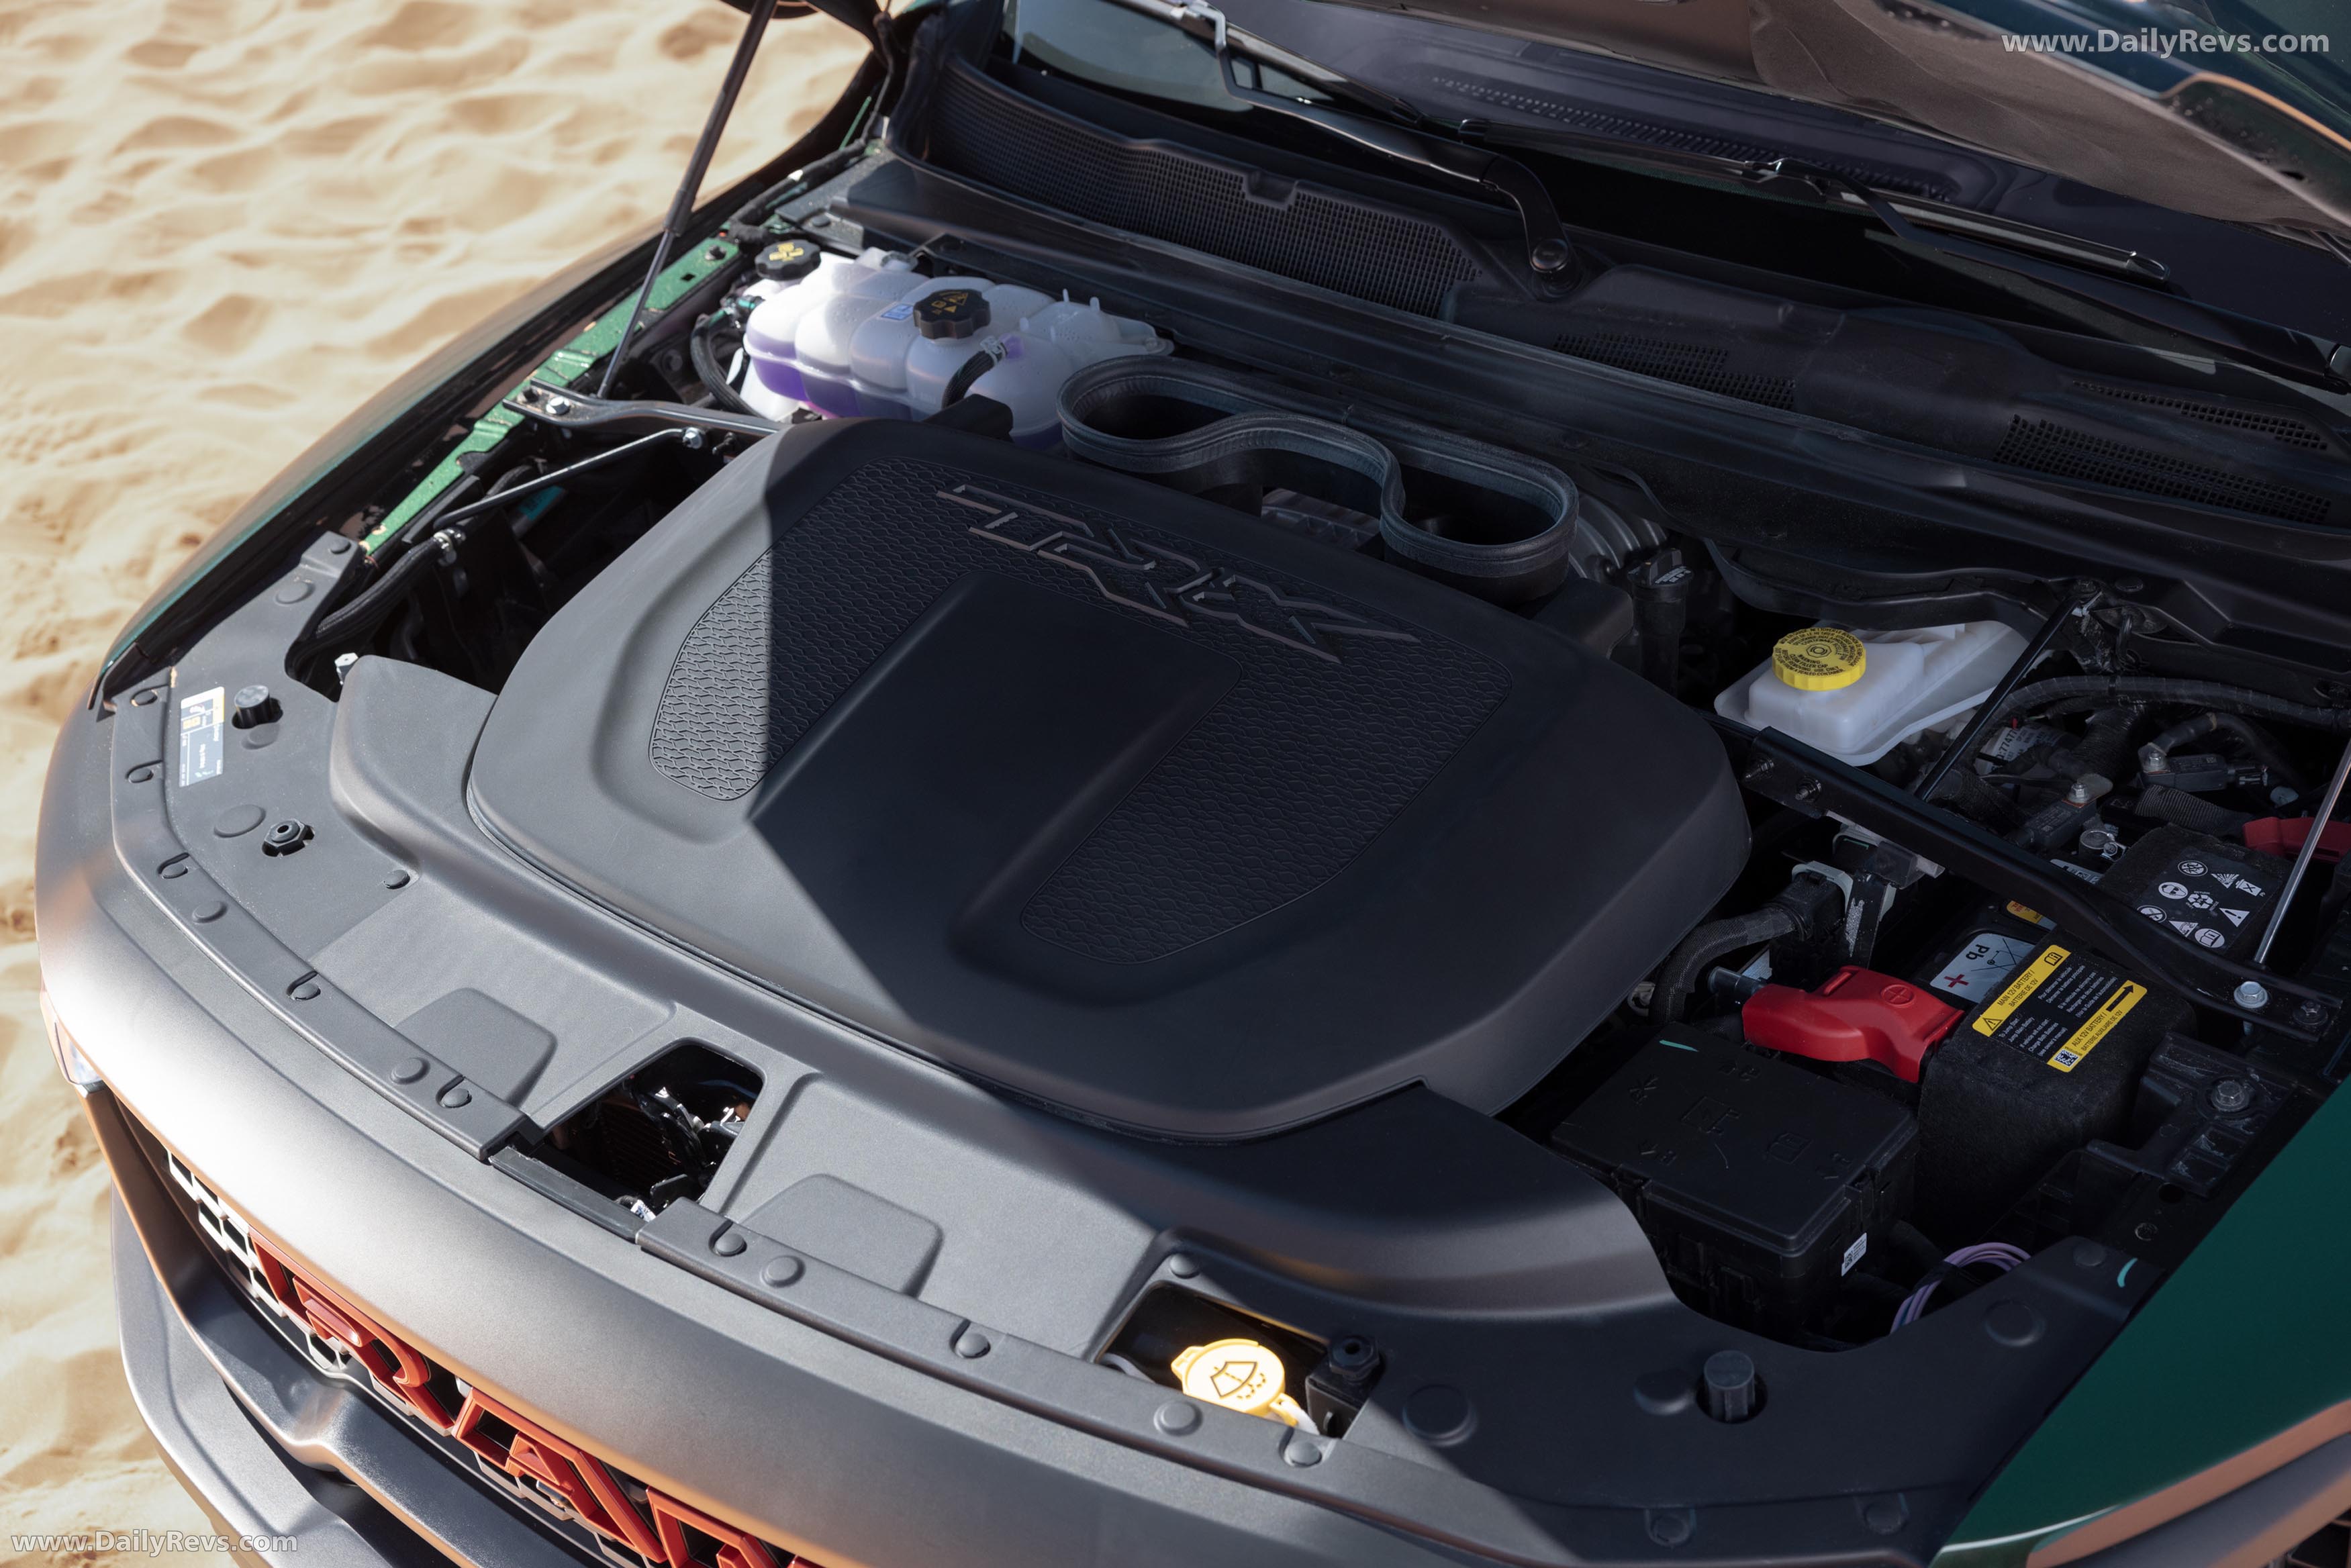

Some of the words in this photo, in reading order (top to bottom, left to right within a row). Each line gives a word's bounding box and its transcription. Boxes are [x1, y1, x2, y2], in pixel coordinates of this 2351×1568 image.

[935, 483, 1421, 665] TRX
[1966, 944, 1990, 960] Pb
[1997, 995, 2010, 1006] MAIN
[2007, 987, 2017, 996] 12V
[2014, 971, 2033, 989] BATTERY
[2009, 989, 2027, 1007] BATTERIE
[2003, 1025, 2013, 1034] Jump
[2008, 1034, 2019, 1042] Jump
[2021, 1016, 2035, 1028] Battery
[2028, 1040, 2041, 1052] Charge
[2037, 1034, 2048, 1042] Both
[2044, 1022, 2059, 1035] Batteries
[2072, 1036, 2083, 1047] AUX
[2080, 1030, 2089, 1038] 12V
[2086, 1014, 2105, 1032] BATTERY
[2081, 1035, 2098, 1051] BATTERIE
[2095, 1020, 2113, 1037] AUXILIAIRE
